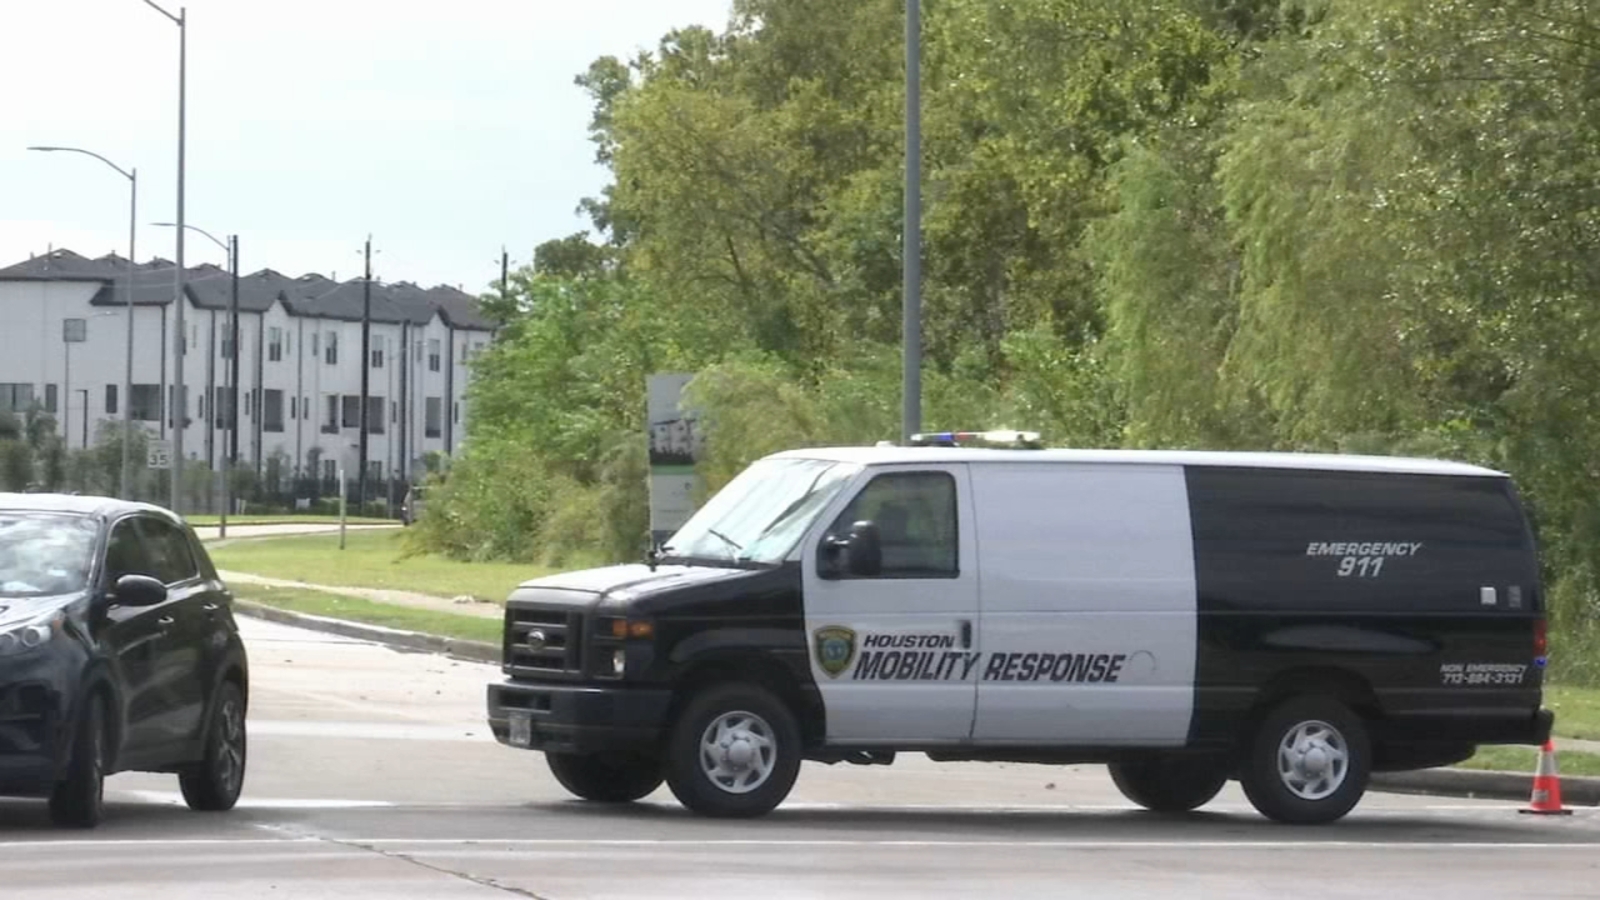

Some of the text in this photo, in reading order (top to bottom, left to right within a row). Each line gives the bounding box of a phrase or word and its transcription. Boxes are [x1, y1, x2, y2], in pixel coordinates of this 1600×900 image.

[149, 454, 168, 466] 35
[1306, 542, 1422, 556] EMERGENCY
[1337, 556, 1384, 577] 911
[863, 634, 955, 648] HOUSTON
[853, 651, 1127, 682] MOBILITY RESPONSE
[1440, 664, 1528, 672] NON EMERGENCY
